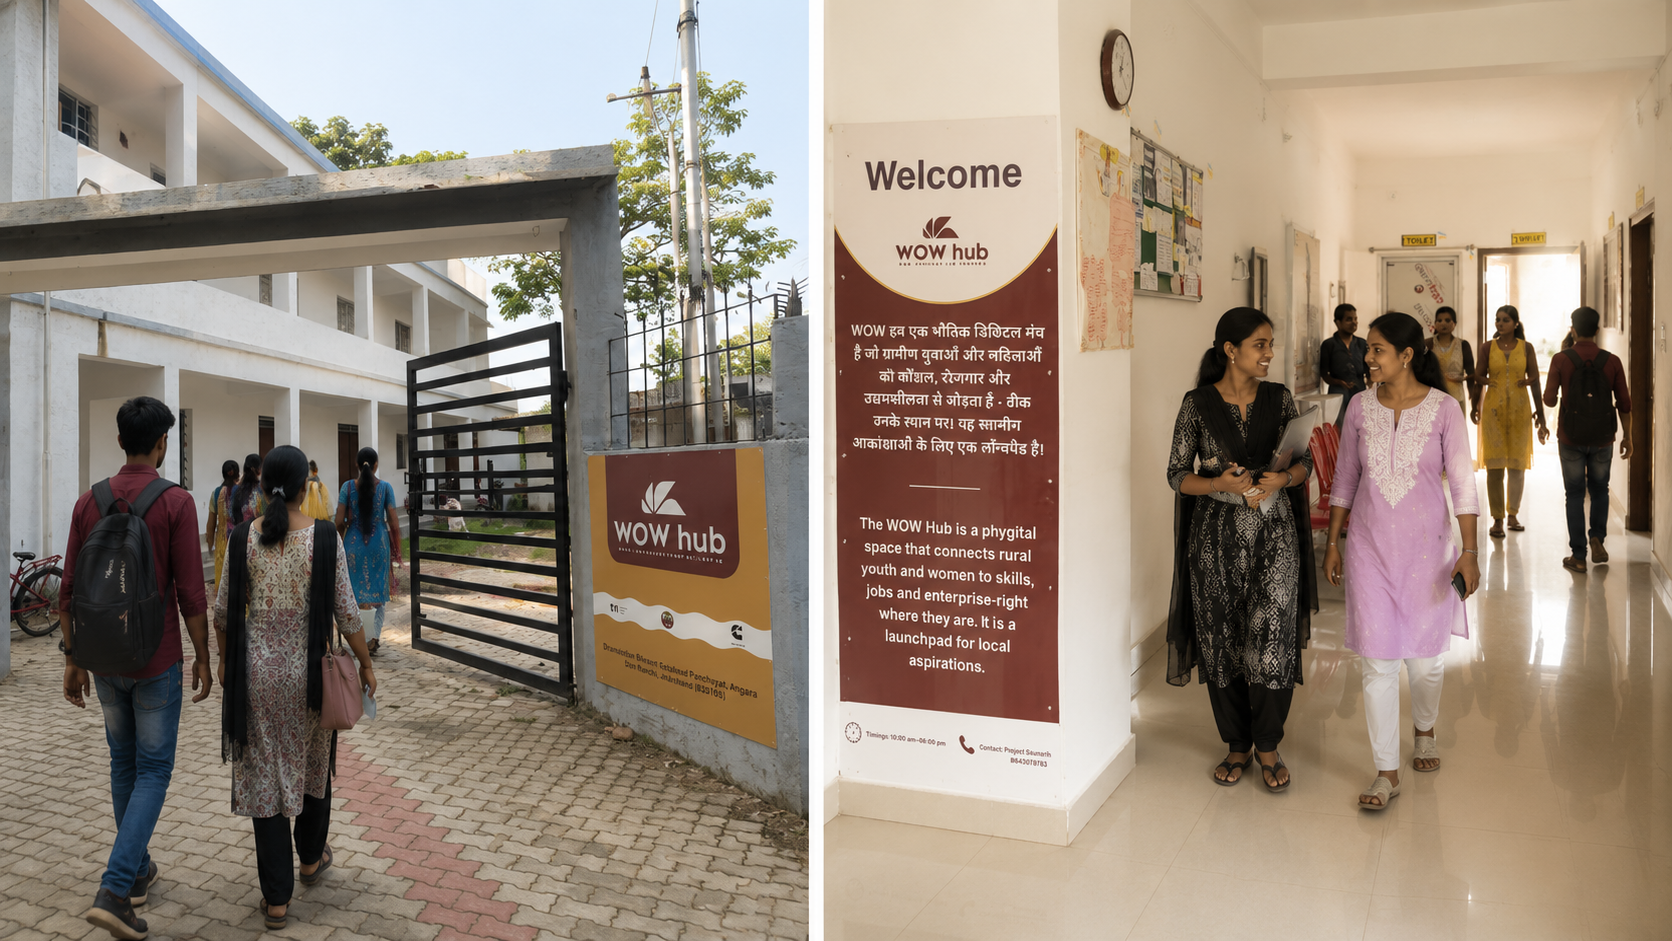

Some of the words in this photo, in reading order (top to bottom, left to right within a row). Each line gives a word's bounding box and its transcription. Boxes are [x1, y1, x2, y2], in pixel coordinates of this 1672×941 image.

[865, 160, 1021, 190] Welcome
[896, 245, 946, 260] WOW
[953, 243, 988, 260] hub
[851, 325, 885, 336] WOW
[909, 326, 928, 339] एक
[864, 345, 879, 359] जो
[932, 391, 942, 406] से
[916, 436, 927, 450] के
[931, 437, 954, 455] लिए
[957, 442, 977, 455] एक
[614, 521, 670, 547] WOW
[678, 524, 725, 554] hub
[860, 517, 883, 530] The
[887, 519, 922, 532] WOW
[926, 521, 952, 534] Hub
[956, 523, 966, 535] is
[971, 527, 978, 536] a
[983, 525, 1036, 541] phygital
[865, 543, 901, 555] space
[905, 543, 930, 555] that
[934, 547, 995, 560] connects
[1000, 550, 1031, 562] rural
[861, 563, 896, 577] youth
[901, 565, 923, 577] and
[928, 569, 974, 581] women
[979, 571, 991, 582] to
[996, 571, 1034, 588] skills,
[866, 584, 893, 599] jobs
[897, 588, 920, 600] and
[925, 590, 1028, 610] enterprise-right
[879, 608, 918, 622] where
[922, 611, 950, 627] they
[954, 616, 977, 627] are.
[982, 616, 989, 628] It
[993, 616, 1004, 629] is
[1008, 621, 1015, 630] a
[886, 629, 952, 648] launchpad
[956, 636, 975, 649] for
[979, 638, 1010, 652] local
[909, 656, 985, 673] aspirations.
[730, 683, 758, 698] Angara
